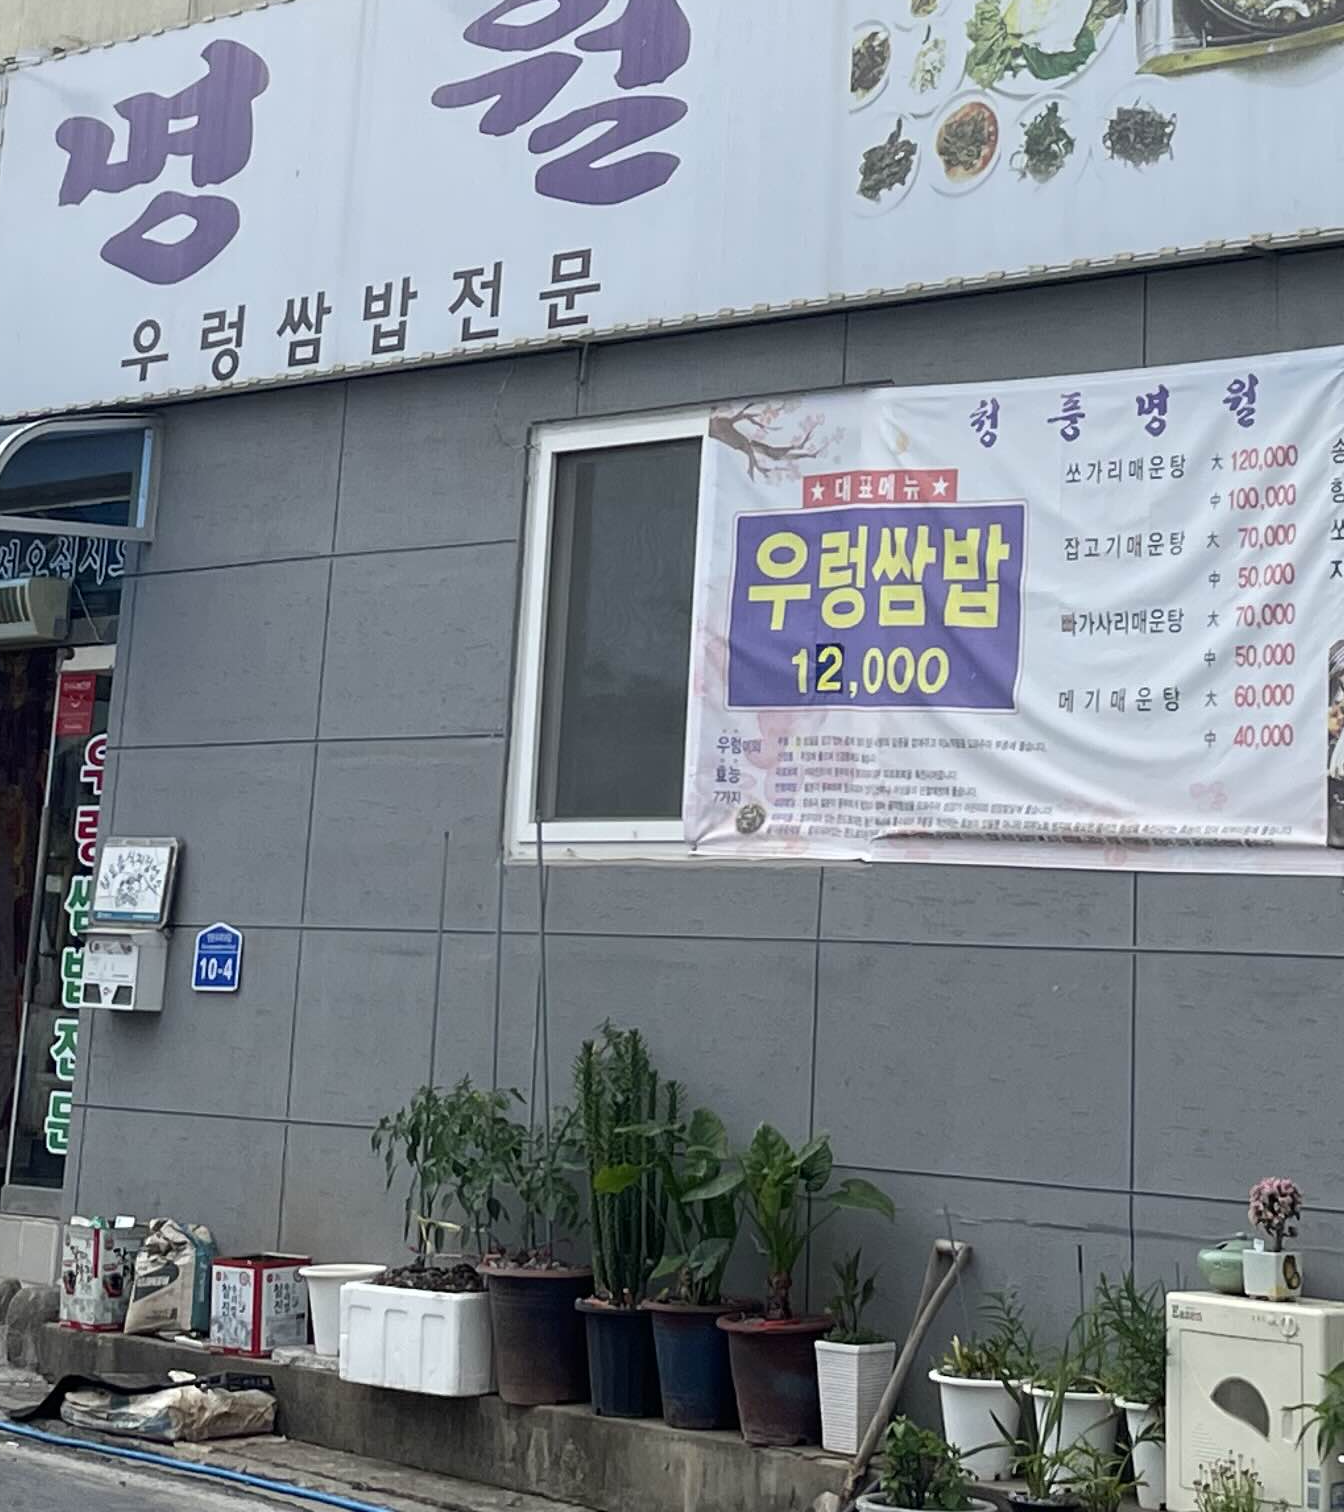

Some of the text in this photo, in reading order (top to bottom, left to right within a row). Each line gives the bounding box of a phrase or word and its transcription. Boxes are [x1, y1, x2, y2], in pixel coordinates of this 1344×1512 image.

[121, 248, 601, 382] 우렁쌈밥전문
[968, 373, 1259, 449] 청풍명월
[1065, 454, 1187, 484] 쏘가리매운탕
[1230, 444, 1299, 472] 120,000
[833, 473, 921, 502] 대표메뉴
[1227, 484, 1297, 511] 100,000
[1063, 531, 1186, 561] 잡고기매운탕
[1237, 524, 1297, 550] 70,000
[748, 524, 1010, 631] 우렁쌈밥
[1237, 562, 1296, 589] 50,000
[1236, 603, 1296, 629] 70,000
[1234, 643, 1296, 669] 50,000
[792, 645, 950, 699] 12,000
[1058, 685, 1181, 713] 메기매운탕
[1234, 683, 1295, 709] 60,000
[1232, 723, 1294, 750] 40,000
[200, 957, 233, 981] 10-4
